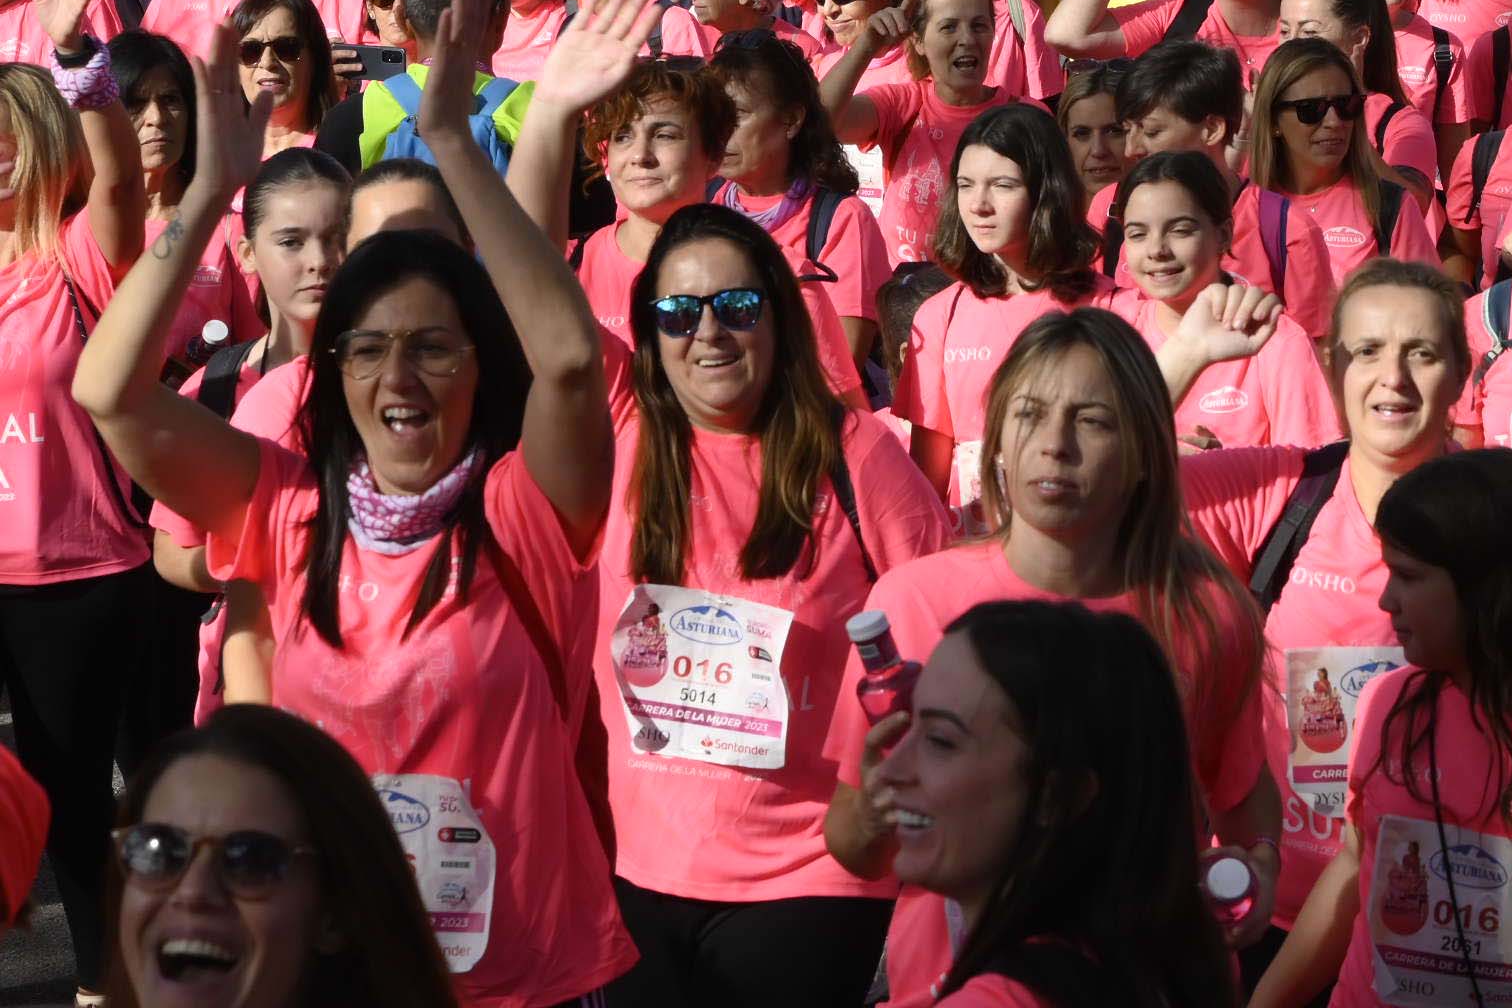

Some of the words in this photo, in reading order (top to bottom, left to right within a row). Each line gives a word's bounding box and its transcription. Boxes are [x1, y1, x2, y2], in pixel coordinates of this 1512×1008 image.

[896, 226, 917, 244] TU
[675, 615, 740, 639] ASTURIANA
[673, 655, 733, 684] 016
[680, 687, 716, 706] 5014
[675, 708, 691, 720] DE
[691, 710, 705, 722] LA
[706, 713, 742, 729] MUJER
[744, 718, 769, 732] 2023
[714, 740, 769, 758] Santander
[440, 917, 469, 928] 2023
[1433, 899, 1500, 933] 016
[1385, 951, 1436, 968] CARRERA
[1439, 960, 1455, 972] DE
